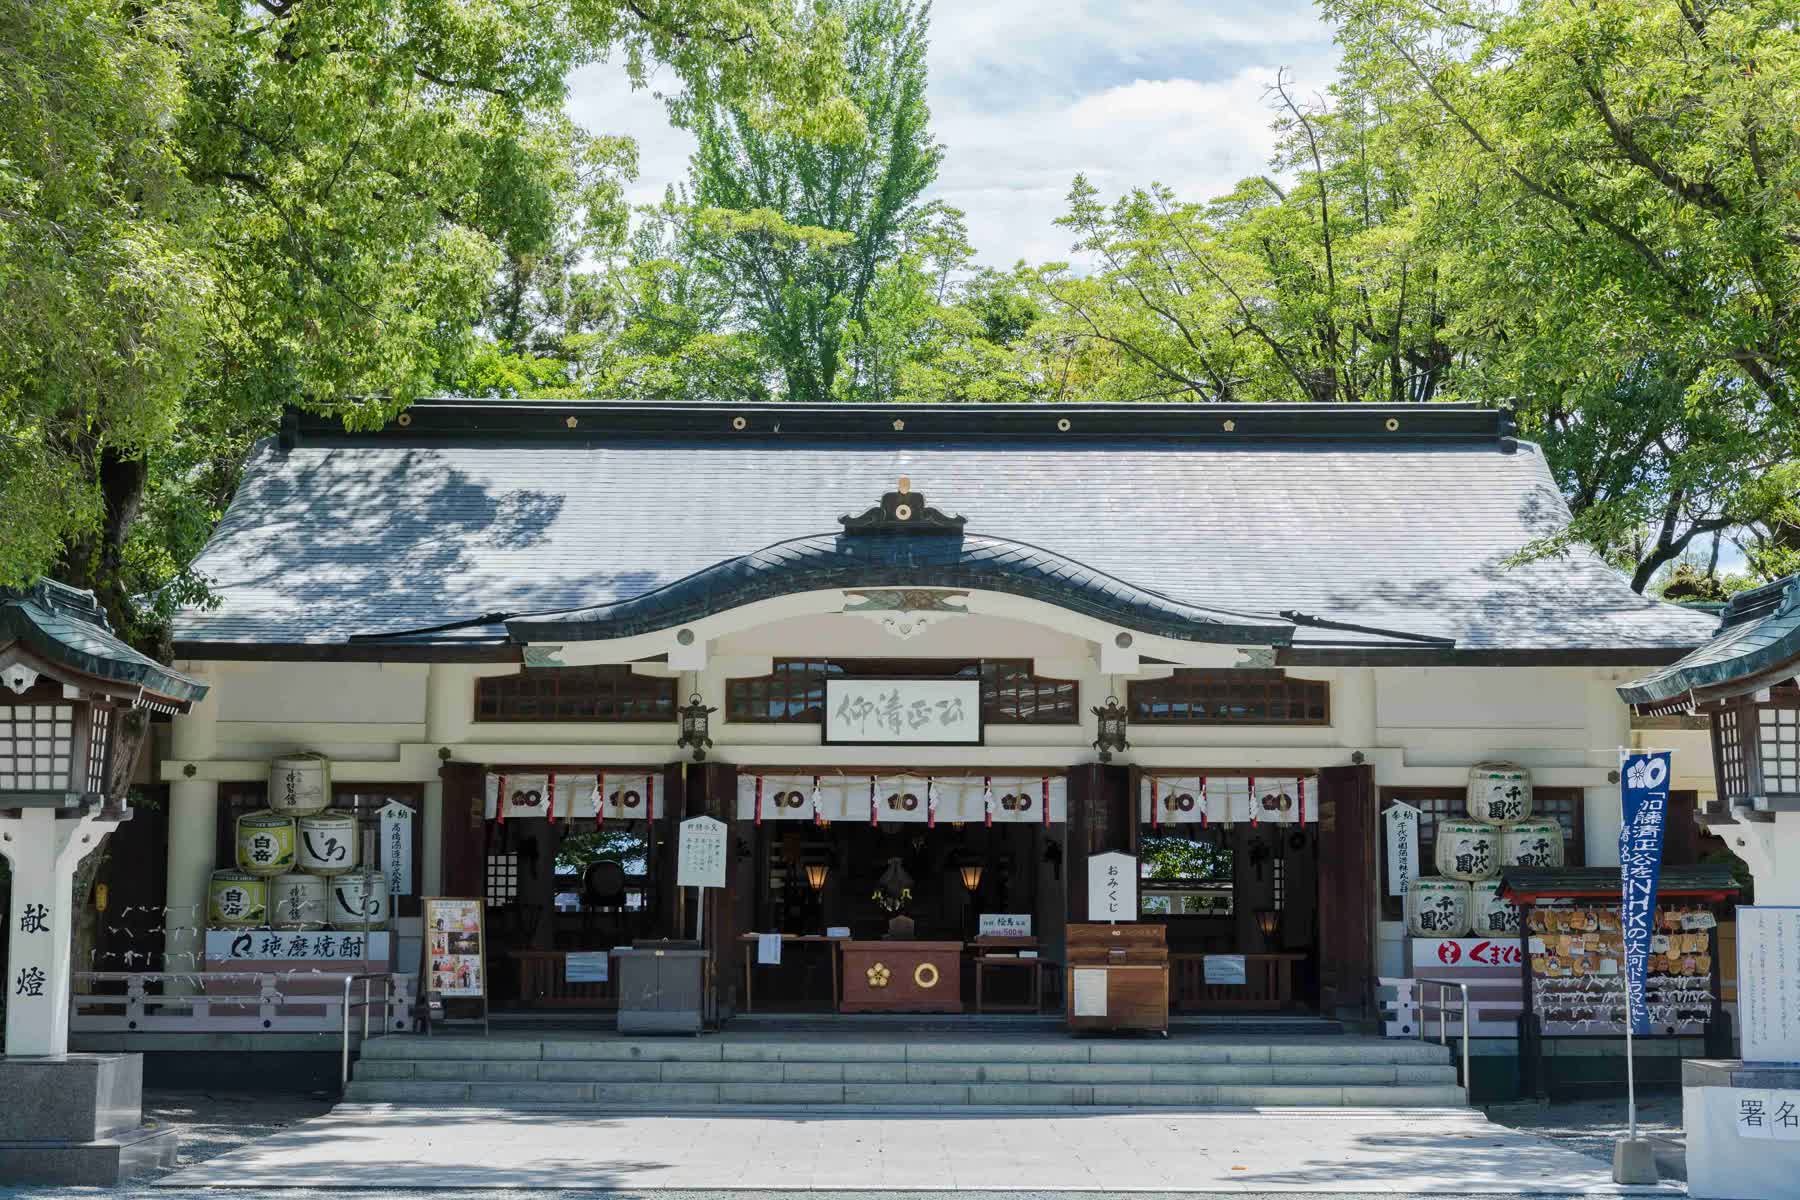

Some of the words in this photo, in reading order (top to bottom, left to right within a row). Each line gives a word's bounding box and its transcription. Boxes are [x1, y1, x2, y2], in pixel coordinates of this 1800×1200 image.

[252, 836, 273, 862] 白岳
[303, 831, 346, 862] しろ
[1107, 864, 1119, 913] おみくじ
[16, 904, 50, 996] 献燈
[261, 934, 364, 958] 球磨焼酎
[1739, 1099, 1798, 1128] 署名
